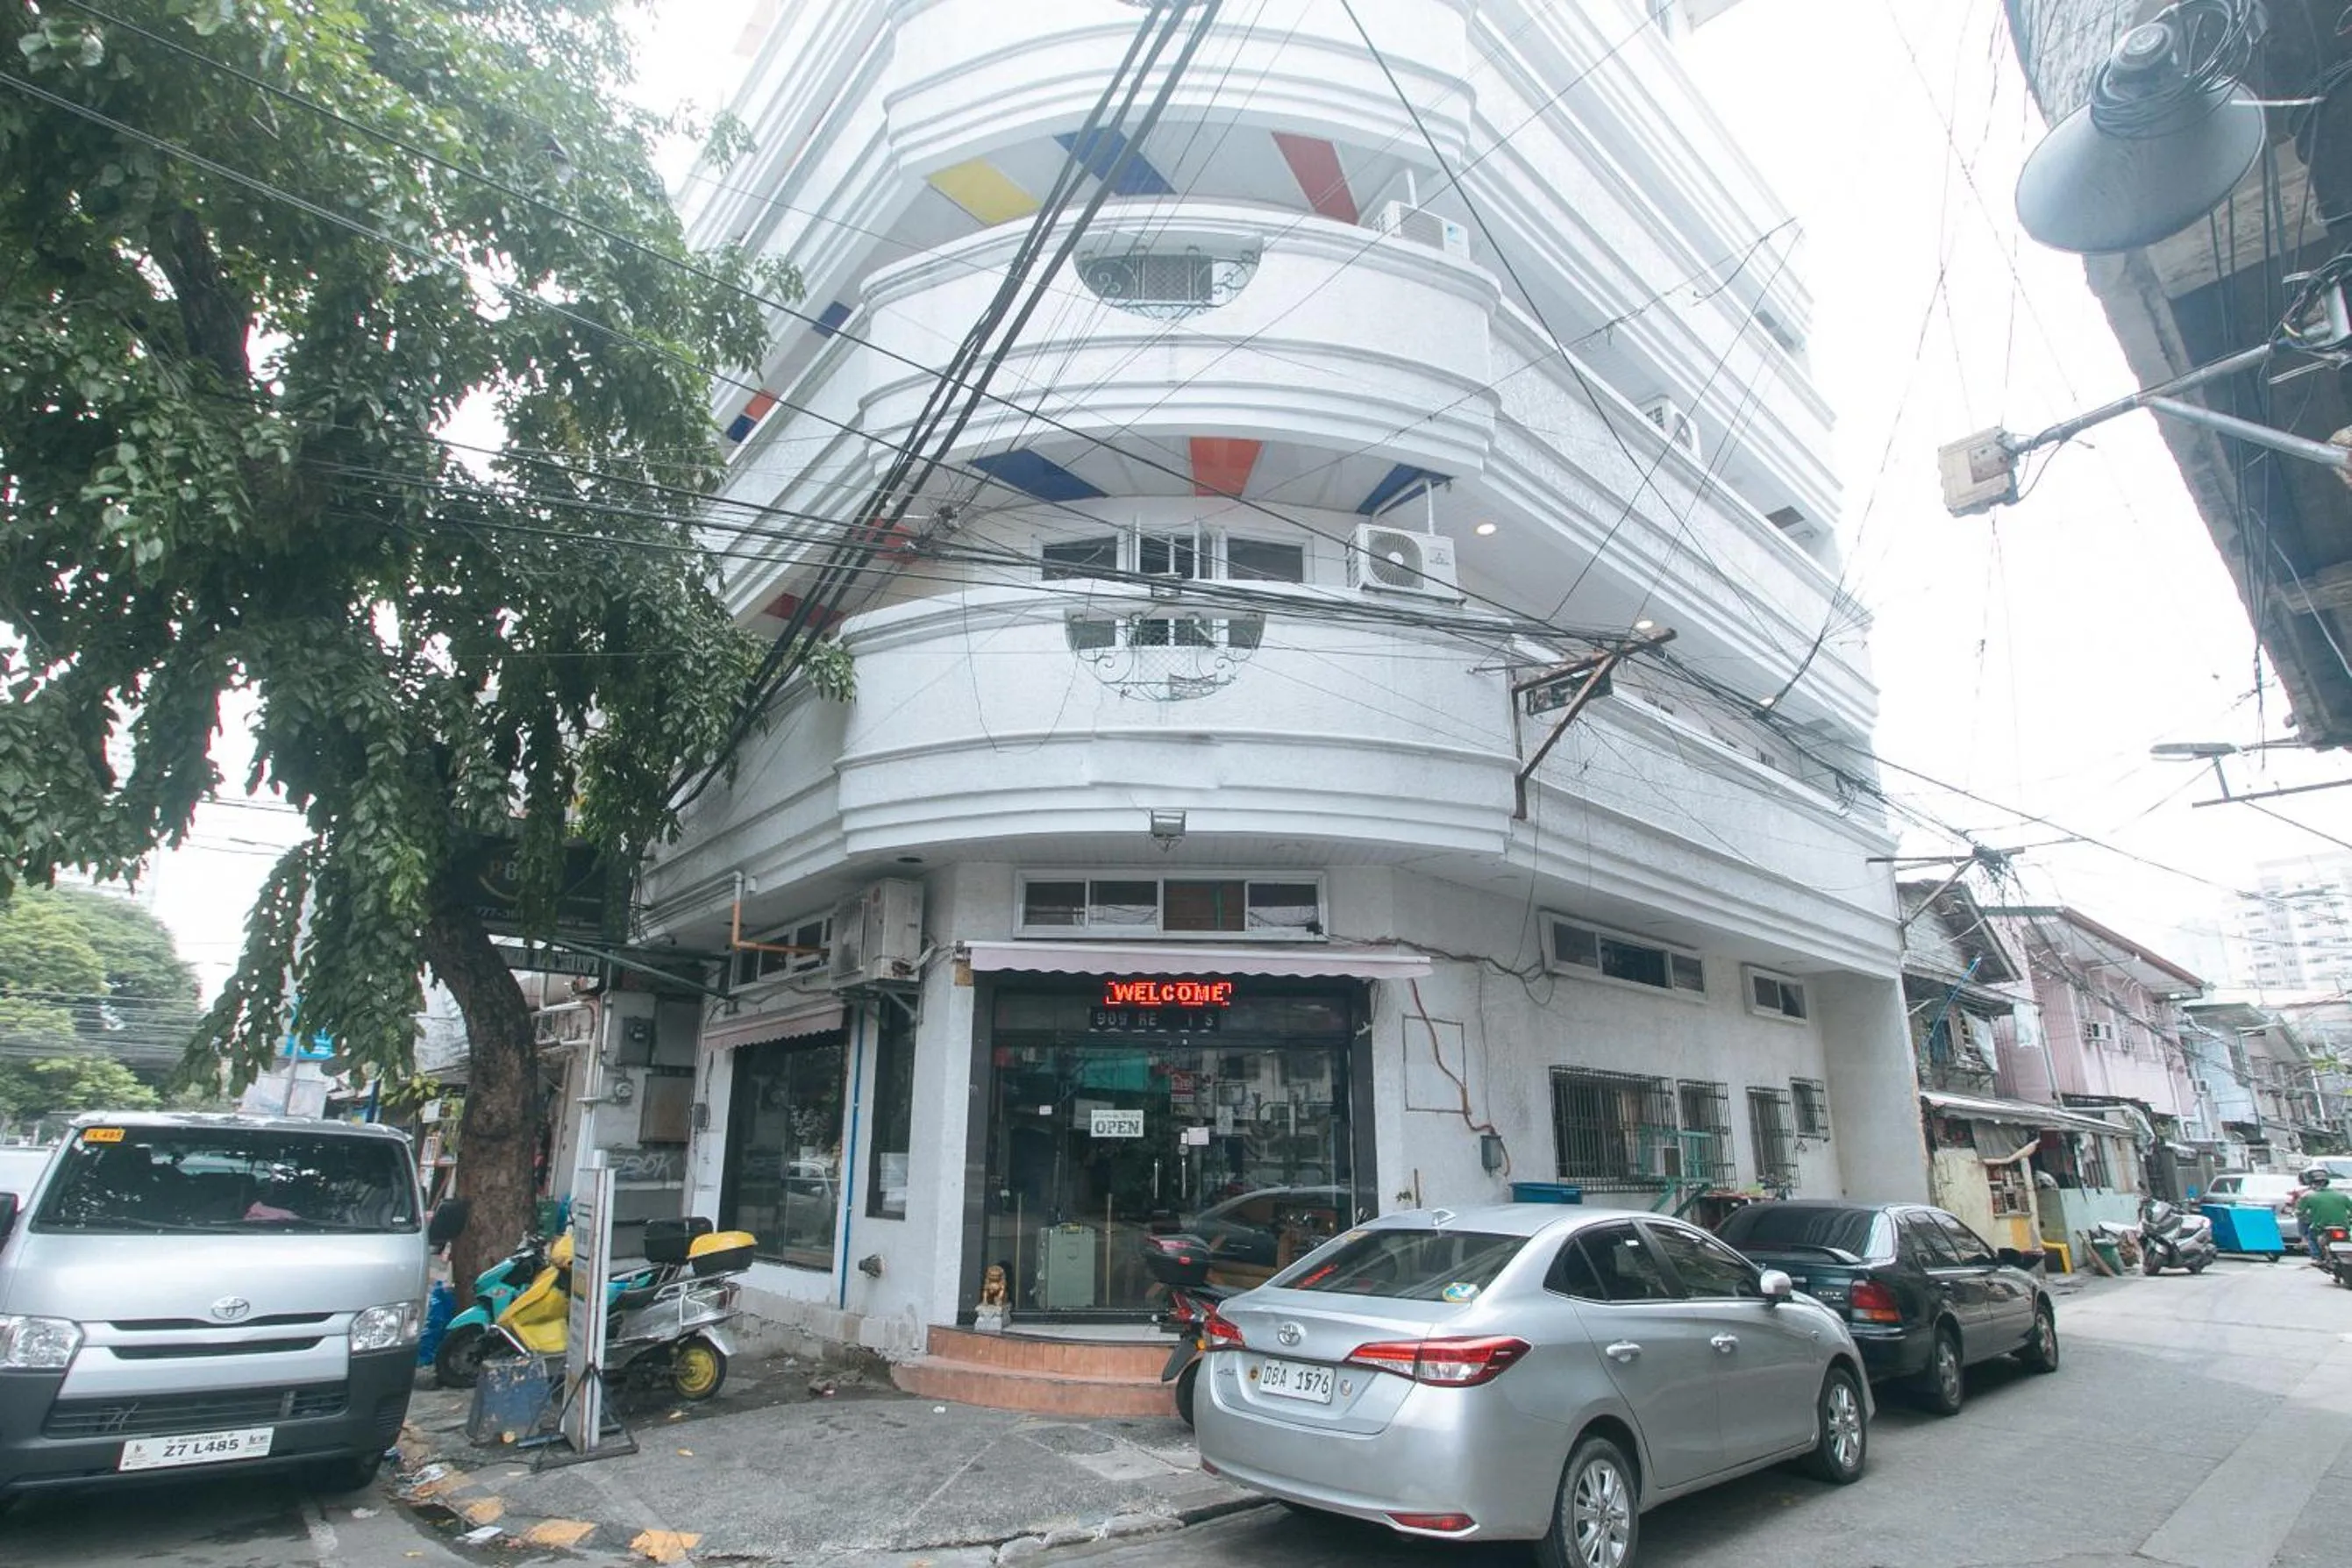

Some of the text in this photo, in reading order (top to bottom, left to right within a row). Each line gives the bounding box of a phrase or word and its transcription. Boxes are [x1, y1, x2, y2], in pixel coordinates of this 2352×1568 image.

[1113, 983, 1224, 1001] WELCOME
[1094, 1120, 1140, 1134] OPEN
[1262, 1365, 1287, 1386] DBA
[162, 1443, 189, 1458] Z7
[193, 1438, 239, 1455] L485
